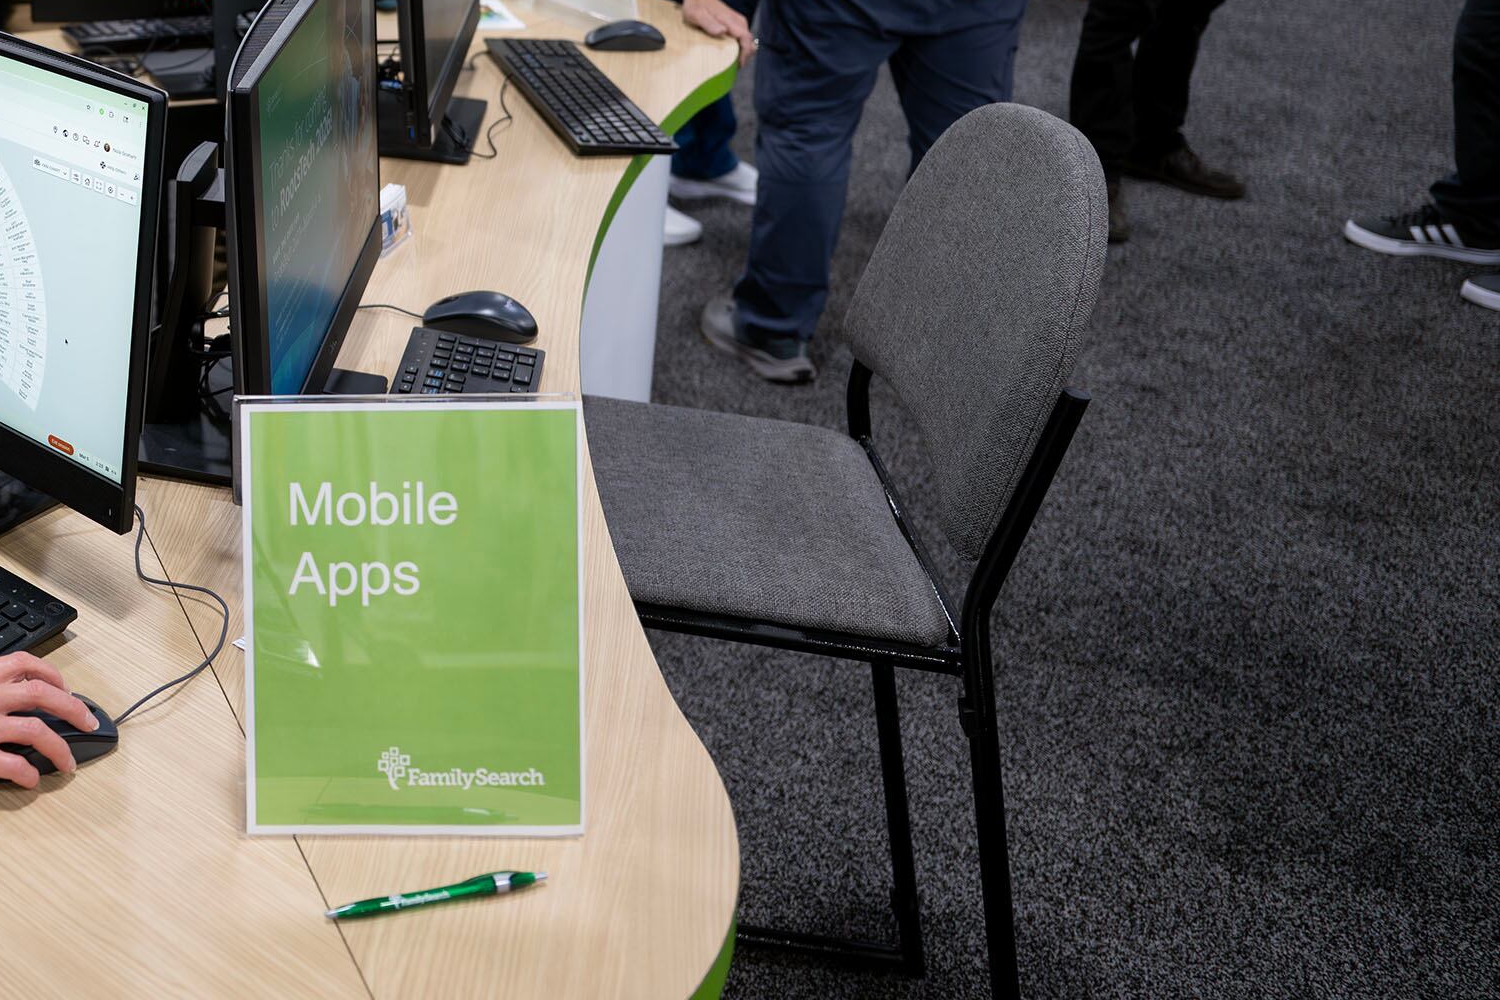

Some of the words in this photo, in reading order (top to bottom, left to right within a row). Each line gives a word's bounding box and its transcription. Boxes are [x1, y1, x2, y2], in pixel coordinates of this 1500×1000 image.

[279, 138, 316, 217] RootsTech
[289, 481, 459, 526] Mobile
[288, 551, 421, 607] Apps
[407, 768, 545, 789] FamilySearch
